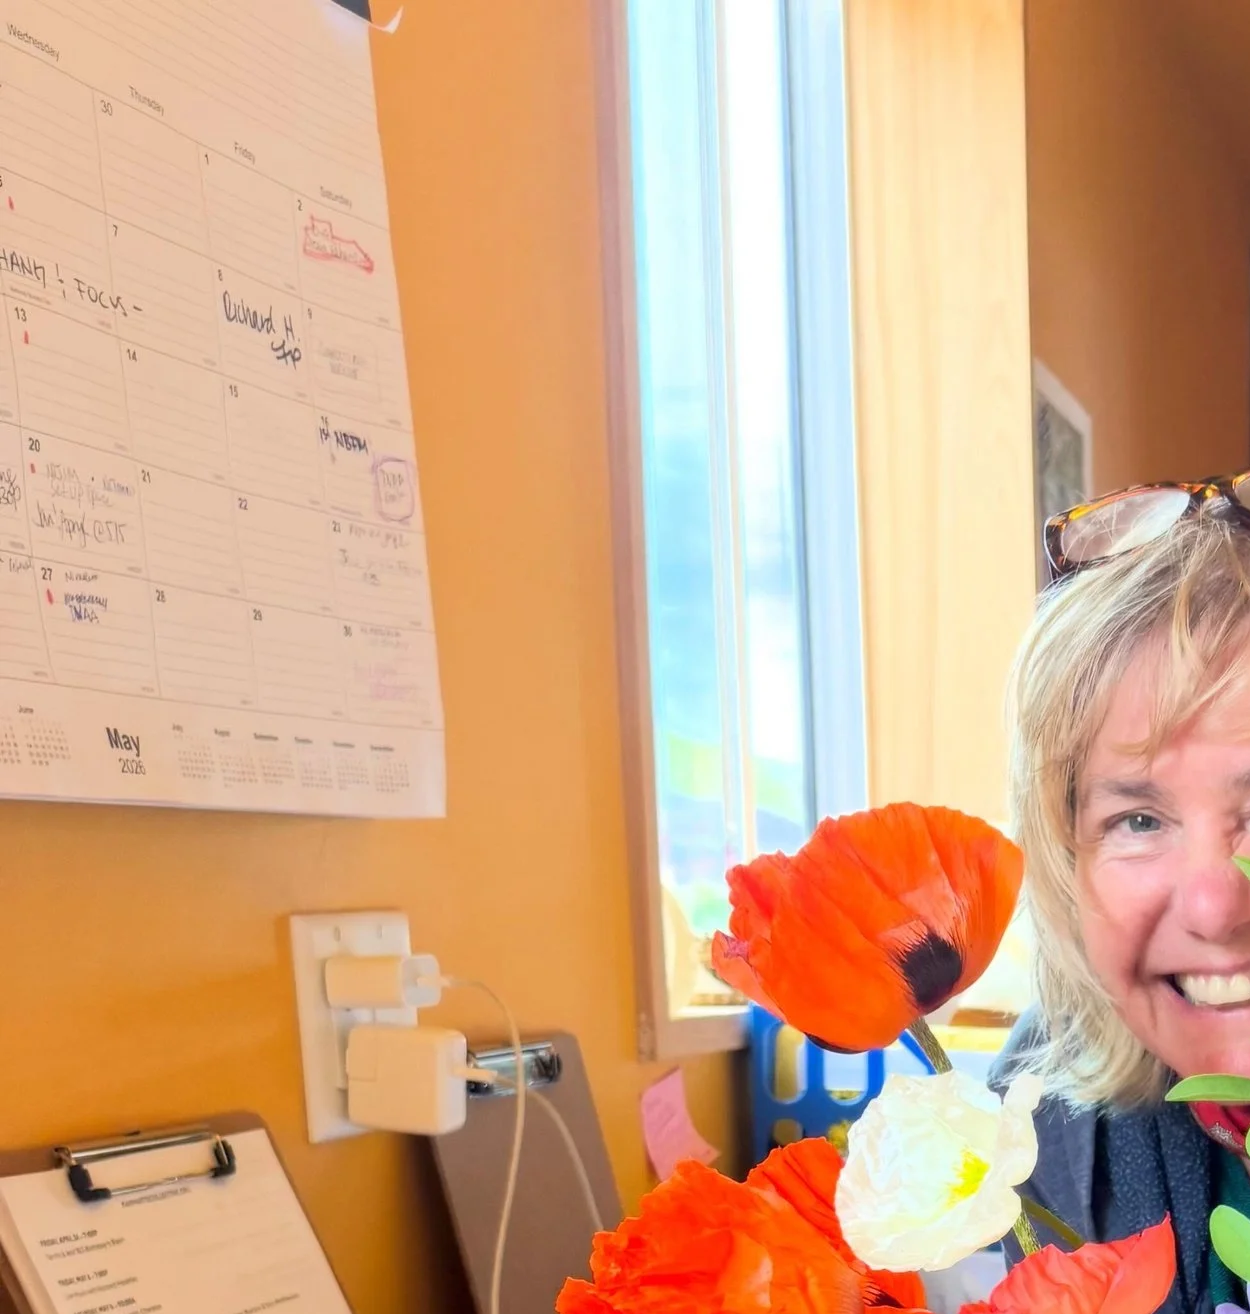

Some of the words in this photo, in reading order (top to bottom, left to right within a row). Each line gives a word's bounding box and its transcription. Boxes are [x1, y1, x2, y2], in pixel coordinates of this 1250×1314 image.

[100, 99, 114, 117] 30
[128, 84, 165, 117] Thursday
[234, 141, 256, 166] Friday
[112, 223, 119, 238] 7
[14, 306, 27, 322] 13
[126, 347, 138, 362] 14
[229, 384, 240, 399] 15
[28, 436, 41, 453] 20
[141, 468, 152, 484] 21
[238, 496, 249, 511] 22
[40, 566, 53, 582] 27
[155, 588, 167, 604] 28
[252, 608, 263, 622] 29
[105, 725, 142, 759] May
[118, 756, 147, 776] 2026
